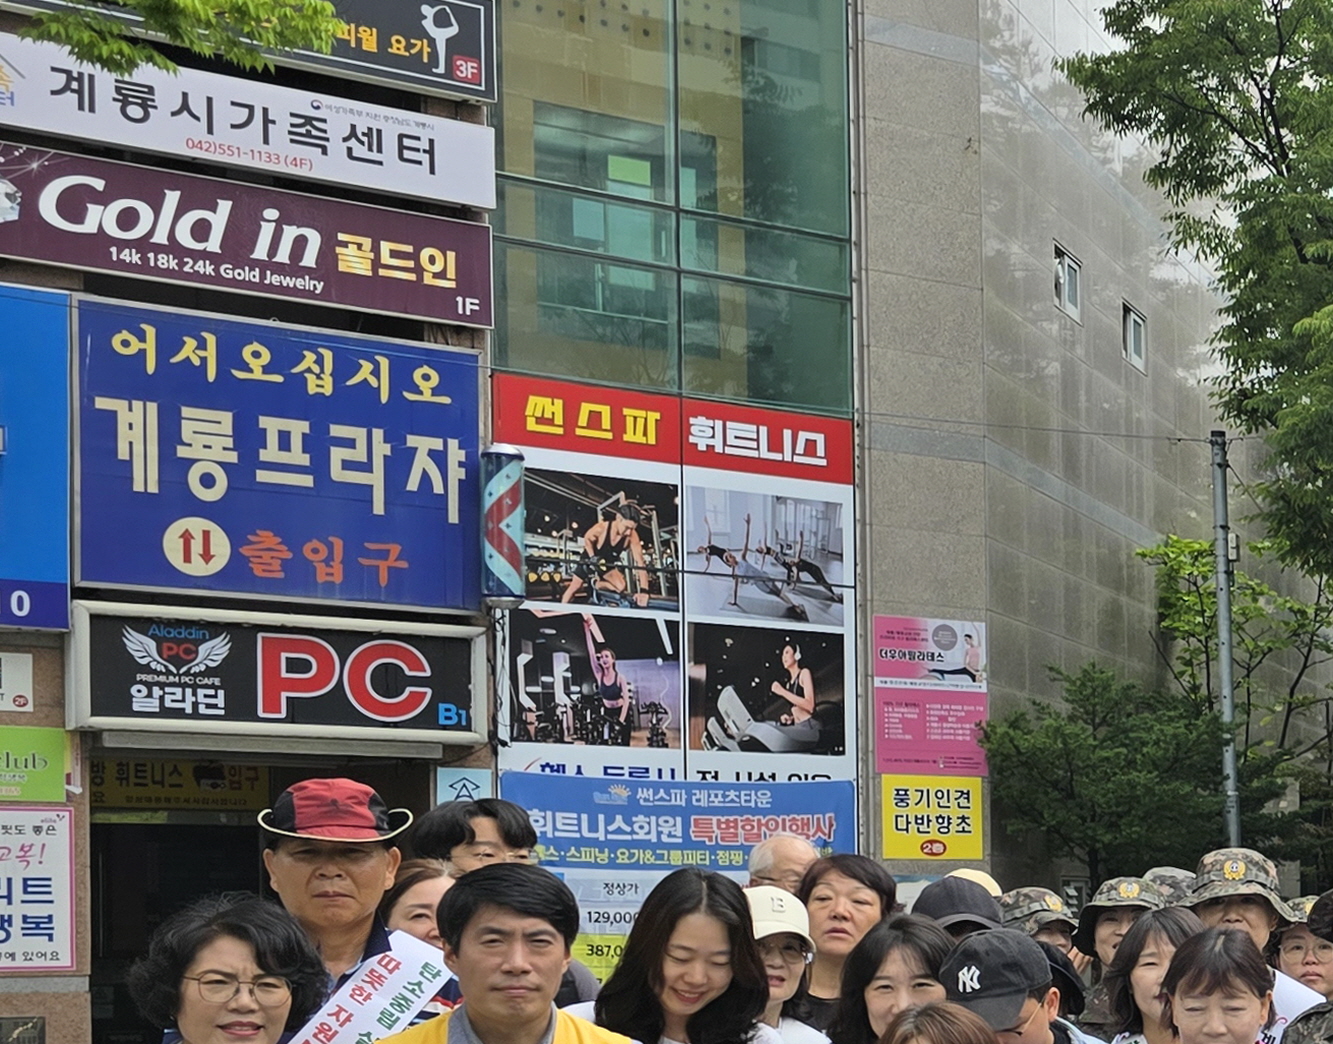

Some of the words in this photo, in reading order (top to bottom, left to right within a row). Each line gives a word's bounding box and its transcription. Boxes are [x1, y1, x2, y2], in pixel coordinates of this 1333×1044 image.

[387, 33, 432, 63] 요가
[455, 59, 479, 80] 3F
[49, 66, 438, 176] 계룡시가족센터
[185, 137, 282, 166] 042)551-1133
[283, 153, 314, 173] (4F)
[38, 175, 233, 254] Gold
[250, 207, 323, 269] in
[109, 245, 143, 267] 14k
[147, 251, 180, 271] 18k
[182, 256, 216, 278] 24k
[219, 262, 260, 284] Gold
[264, 269, 325, 294] Jewelry
[335, 231, 458, 289] 골드인
[455, 295, 482, 316] 1F
[111, 322, 453, 405] 어서오십시오
[524, 394, 660, 447] 썬스파
[688, 415, 828, 468] 휘트니스
[94, 396, 467, 525] 계룡프라쟈
[239, 529, 410, 588] 출입구
[147, 623, 211, 641] Aladdin
[161, 641, 198, 662] PC
[136, 673, 180, 684] PREMIUM
[181, 675, 196, 685] PC
[196, 676, 222, 687] CAFE
[256, 632, 433, 724] PC
[130, 682, 226, 717] 알라딘
[437, 702, 468, 727] B1
[115, 761, 184, 789] 휘트니스
[228, 765, 261, 792] 입구
[636, 790, 688, 807] 썬스파
[691, 790, 773, 808] 레포츠타운
[893, 788, 973, 812] 풍기인견
[32, 824, 58, 837] 좋은
[528, 809, 683, 844] 휘트니스회원
[690, 813, 836, 845] 특별할인행사
[894, 812, 973, 836] 다반향초
[603, 881, 640, 896] 정상가
[22, 950, 61, 962] 있어요
[349, 953, 401, 1007] 따뜻한
[957, 965, 981, 993] NY
[376, 960, 443, 1032] 탄소중립
